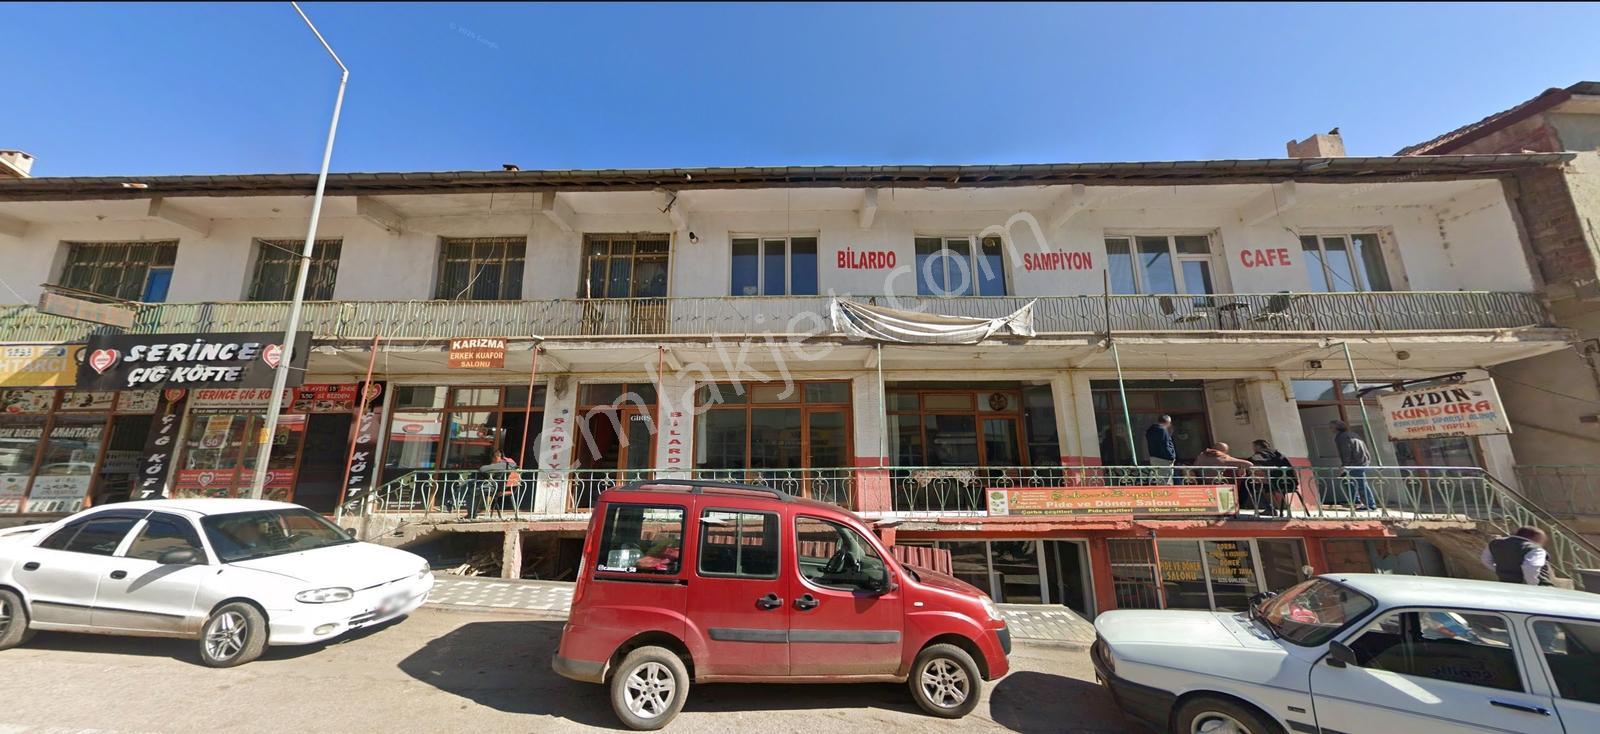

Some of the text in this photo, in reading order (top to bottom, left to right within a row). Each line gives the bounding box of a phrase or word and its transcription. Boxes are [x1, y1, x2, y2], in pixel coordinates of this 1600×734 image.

[837, 246, 897, 269] BİLARDO
[1023, 250, 1093, 272] ŞAMPİYON
[1240, 247, 1292, 268] CAFE
[124, 338, 260, 362] SERİNCE
[452, 338, 505, 350] KARİZMA
[450, 352, 474, 360] ERKEK
[170, 364, 243, 382] KÖFTE
[1401, 388, 1472, 409] AYDIN
[1391, 400, 1491, 421] KUNDURA
[1045, 501, 1074, 509] Pide
[1136, 498, 1181, 507] Salonu
[1167, 571, 1198, 580] SALONU
